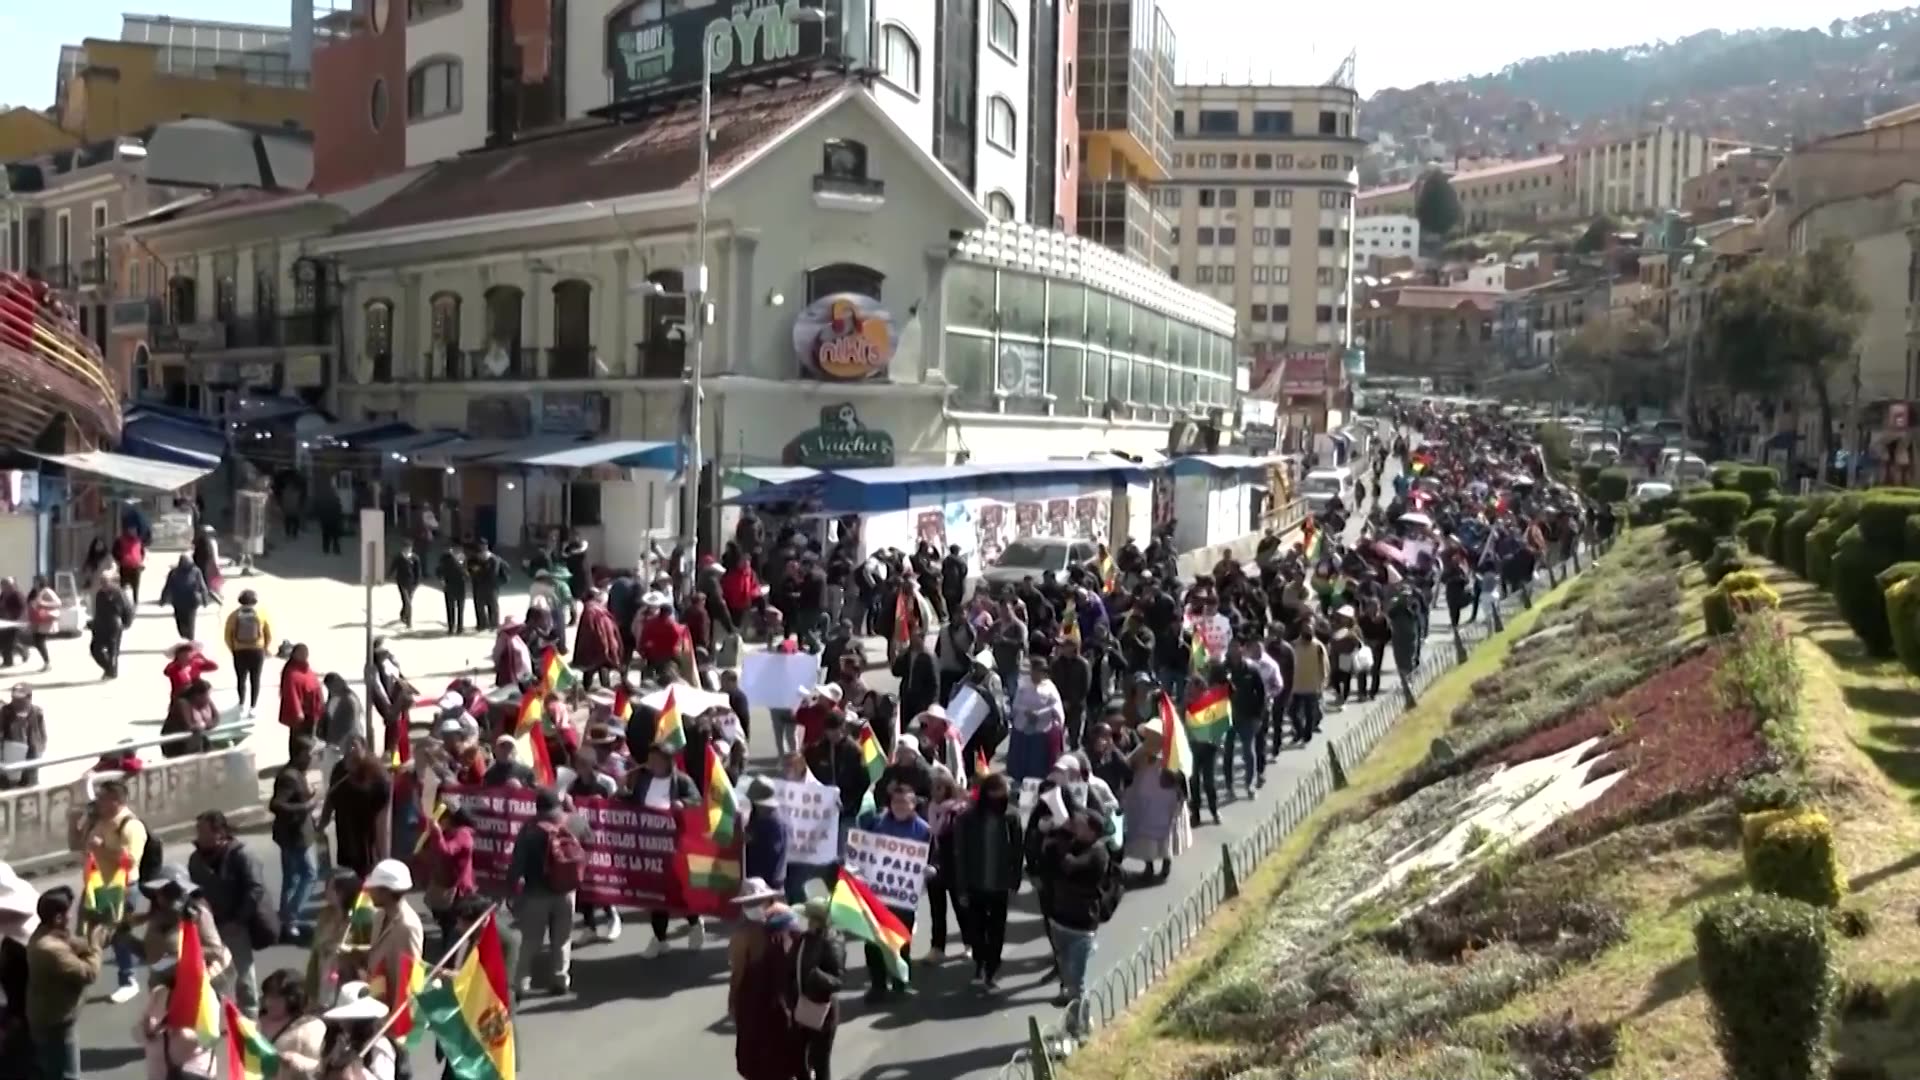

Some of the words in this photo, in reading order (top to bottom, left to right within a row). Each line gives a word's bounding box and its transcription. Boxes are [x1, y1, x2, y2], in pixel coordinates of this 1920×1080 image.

[703, 0, 799, 74] GYM
[508, 799, 537, 816] TRABA
[848, 847, 877, 864] DEL
[875, 837, 926, 858] MOTOR
[629, 856, 642, 871] LA
[644, 858, 664, 873] PAZ
